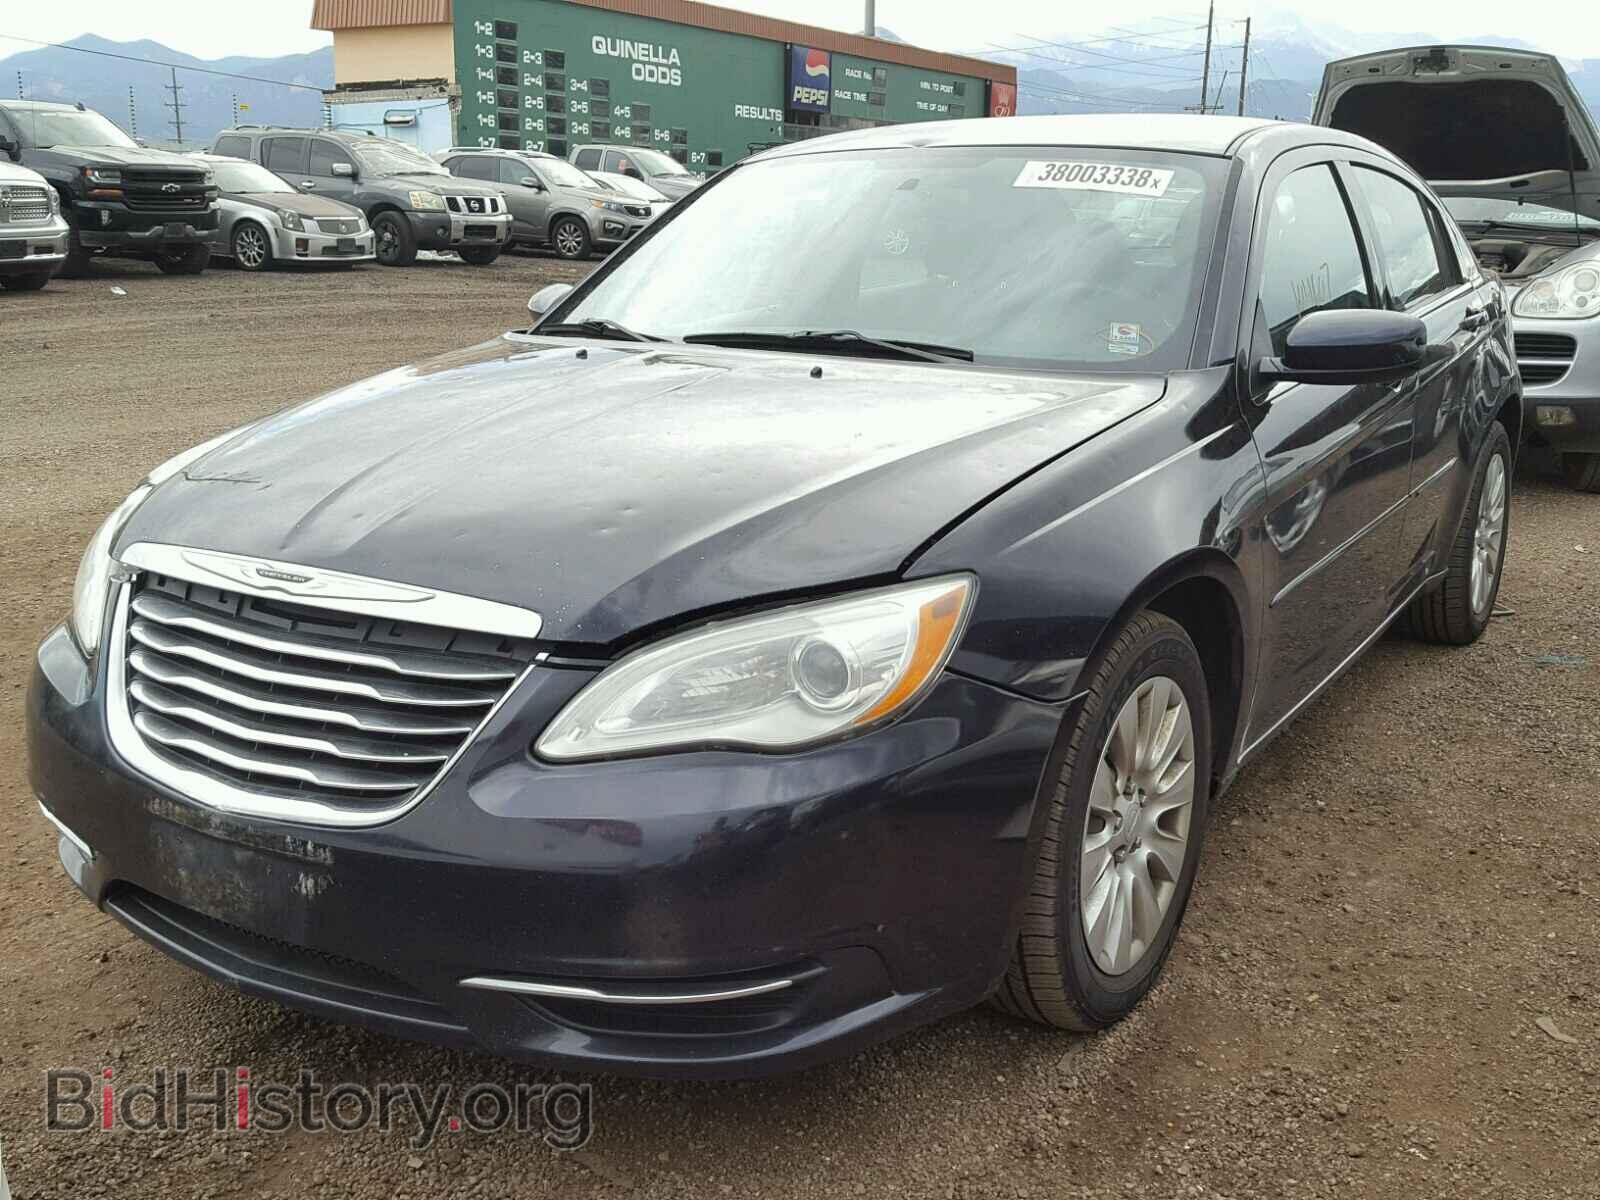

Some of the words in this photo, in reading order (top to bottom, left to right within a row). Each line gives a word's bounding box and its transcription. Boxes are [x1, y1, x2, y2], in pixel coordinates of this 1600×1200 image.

[592, 35, 681, 66] QUINELLA
[632, 63, 682, 86] ODDS
[845, 68, 862, 79] RACE
[793, 86, 828, 106] PEPSI
[834, 89, 852, 100] RACE
[852, 91, 868, 102] TIME
[734, 103, 783, 122] RESULTS
[1038, 163, 1161, 189] 38003338x
